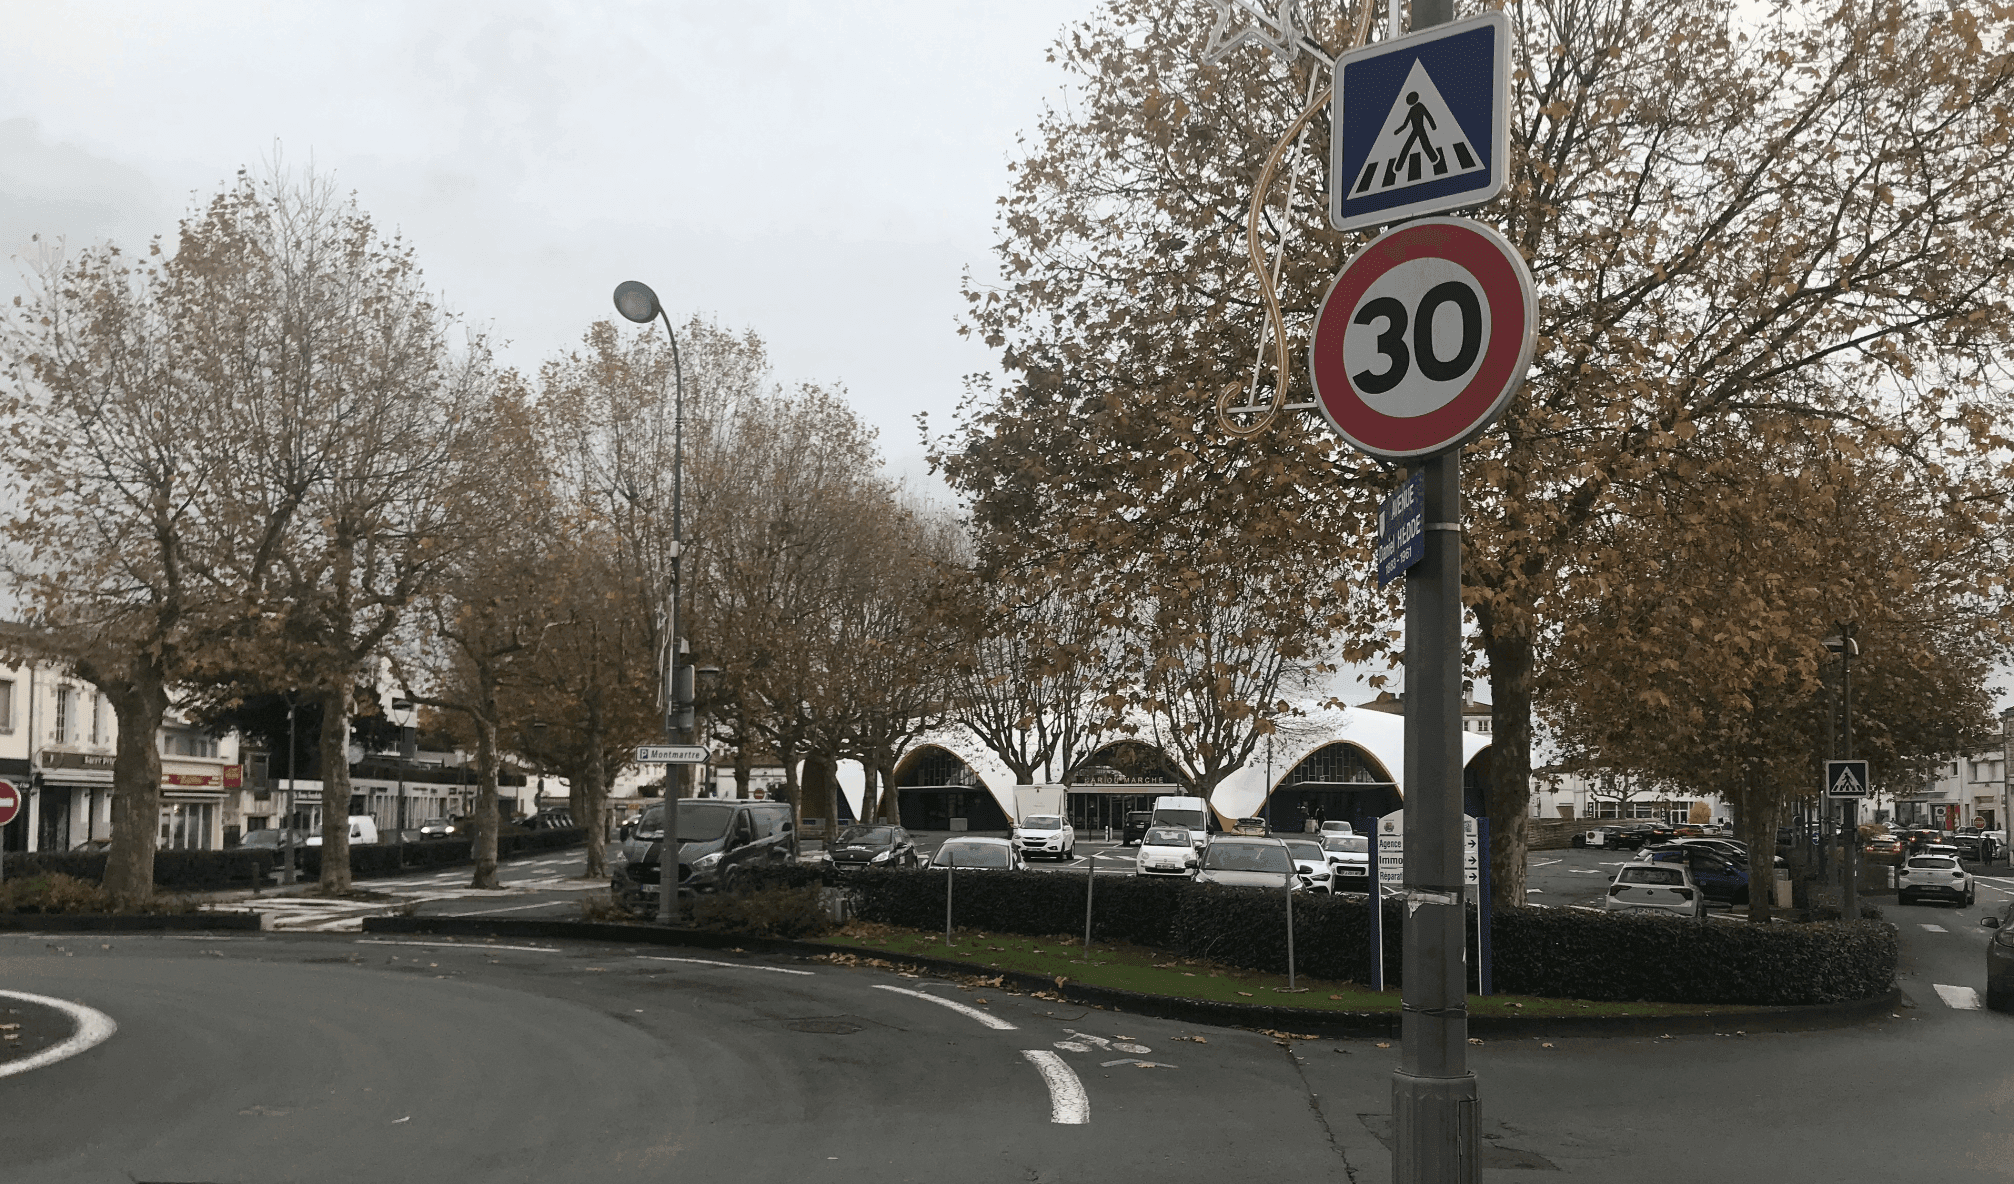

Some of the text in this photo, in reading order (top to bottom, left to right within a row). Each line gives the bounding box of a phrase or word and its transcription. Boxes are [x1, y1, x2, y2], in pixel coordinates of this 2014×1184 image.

[1352, 280, 1483, 395] 30
[1391, 483, 1414, 520] AVENUE
[651, 750, 700, 759] Montmartre
[1379, 839, 1402, 849] Agence
